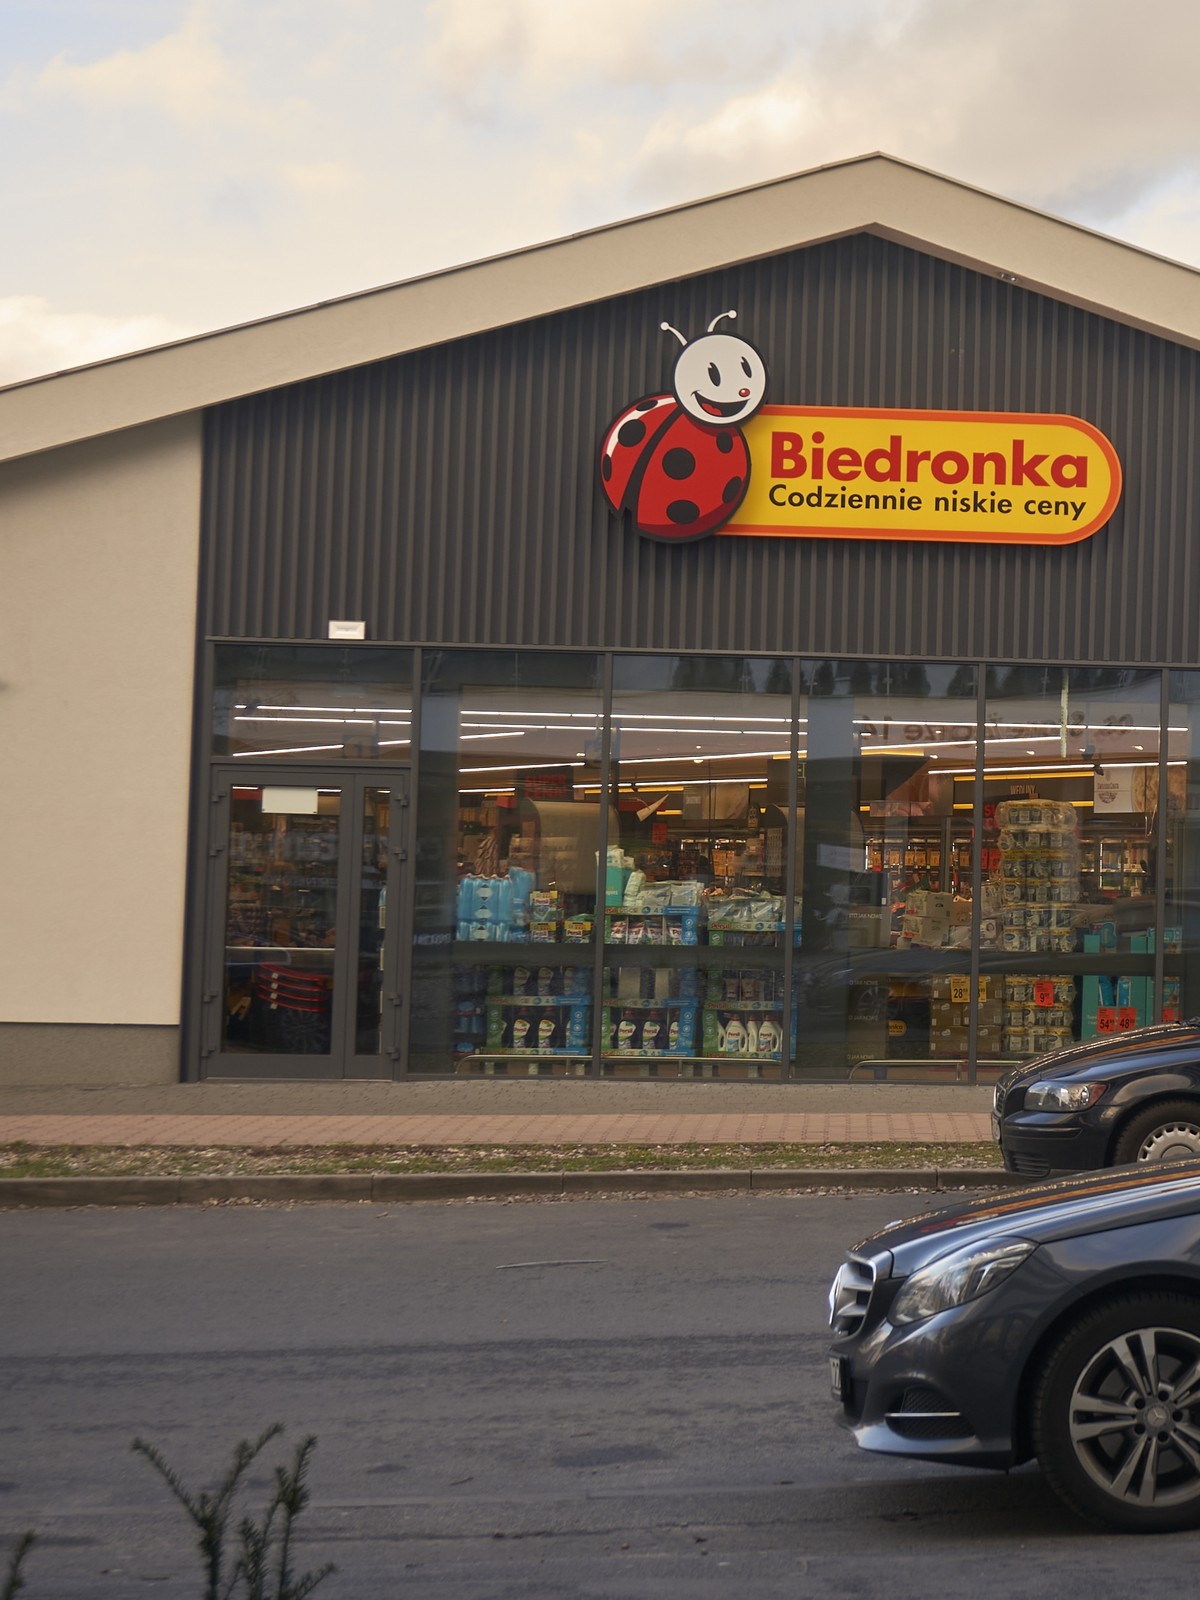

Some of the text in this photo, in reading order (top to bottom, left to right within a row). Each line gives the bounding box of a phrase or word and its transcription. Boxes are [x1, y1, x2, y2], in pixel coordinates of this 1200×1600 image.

[770, 431, 1088, 488] Biedronka
[768, 483, 1086, 521] Codziennie niskie ceny
[953, 988, 963, 998] 28
[1099, 1018, 1110, 1030] 54
[1119, 1018, 1130, 1029] 48
